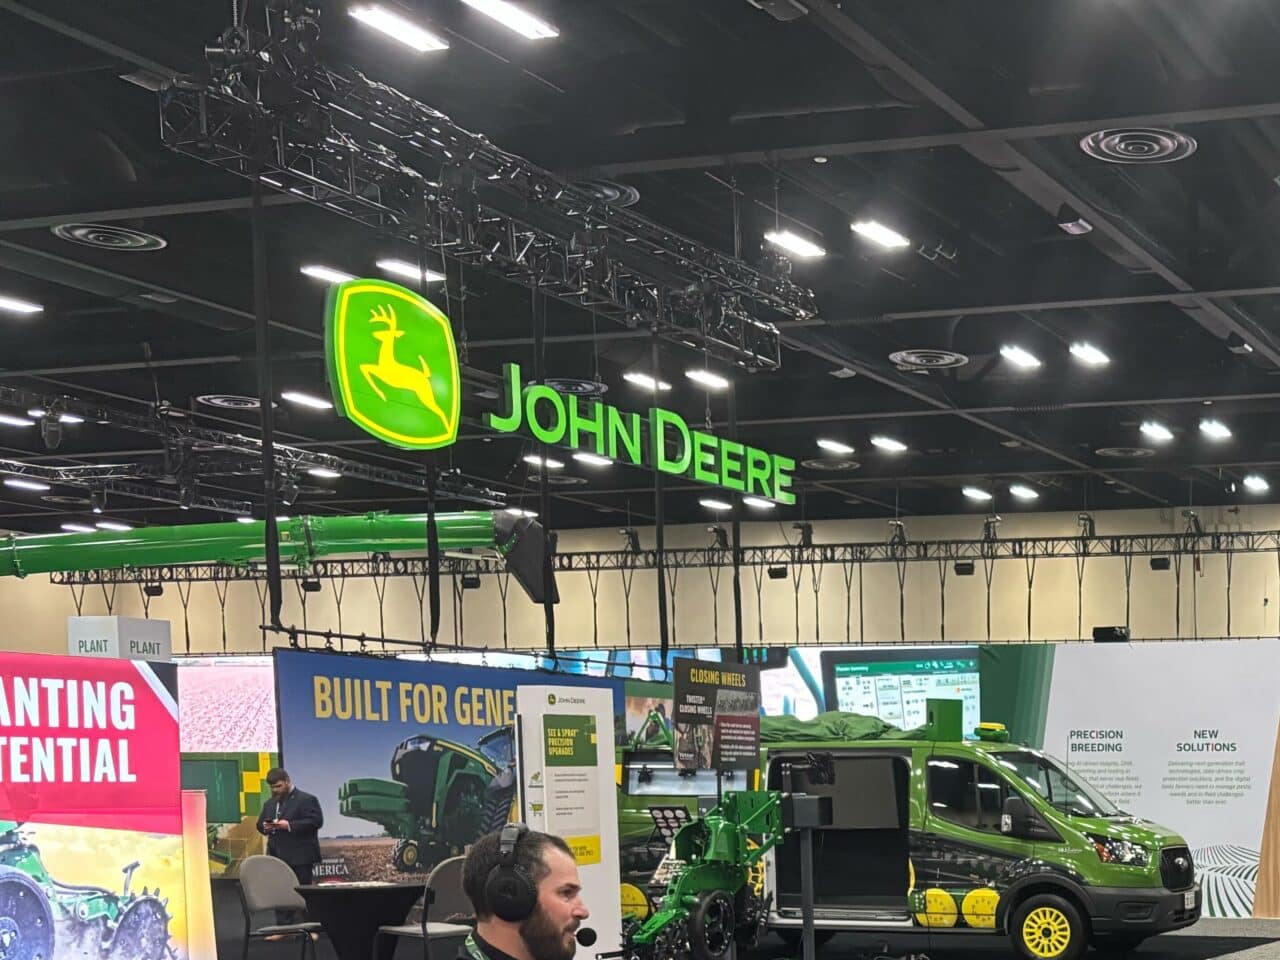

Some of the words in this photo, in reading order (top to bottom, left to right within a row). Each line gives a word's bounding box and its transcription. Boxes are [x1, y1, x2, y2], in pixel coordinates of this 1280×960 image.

[490, 363, 642, 466] JOHN
[648, 407, 798, 505] DEERE
[78, 640, 108, 653] PLANT
[130, 641, 161, 655] PLANT
[690, 668, 720, 685] CLOSING
[721, 671, 746, 687] WHEELS
[313, 675, 392, 722] BUILT
[399, 682, 448, 724] FOR
[454, 686, 518, 727] GENE
[1070, 730, 1123, 740] PRECISION
[1193, 729, 1219, 739] NEW
[1071, 742, 1123, 752] BREEDING
[1176, 742, 1237, 752] SOLUTIONS
[311, 864, 350, 877] MERICA
